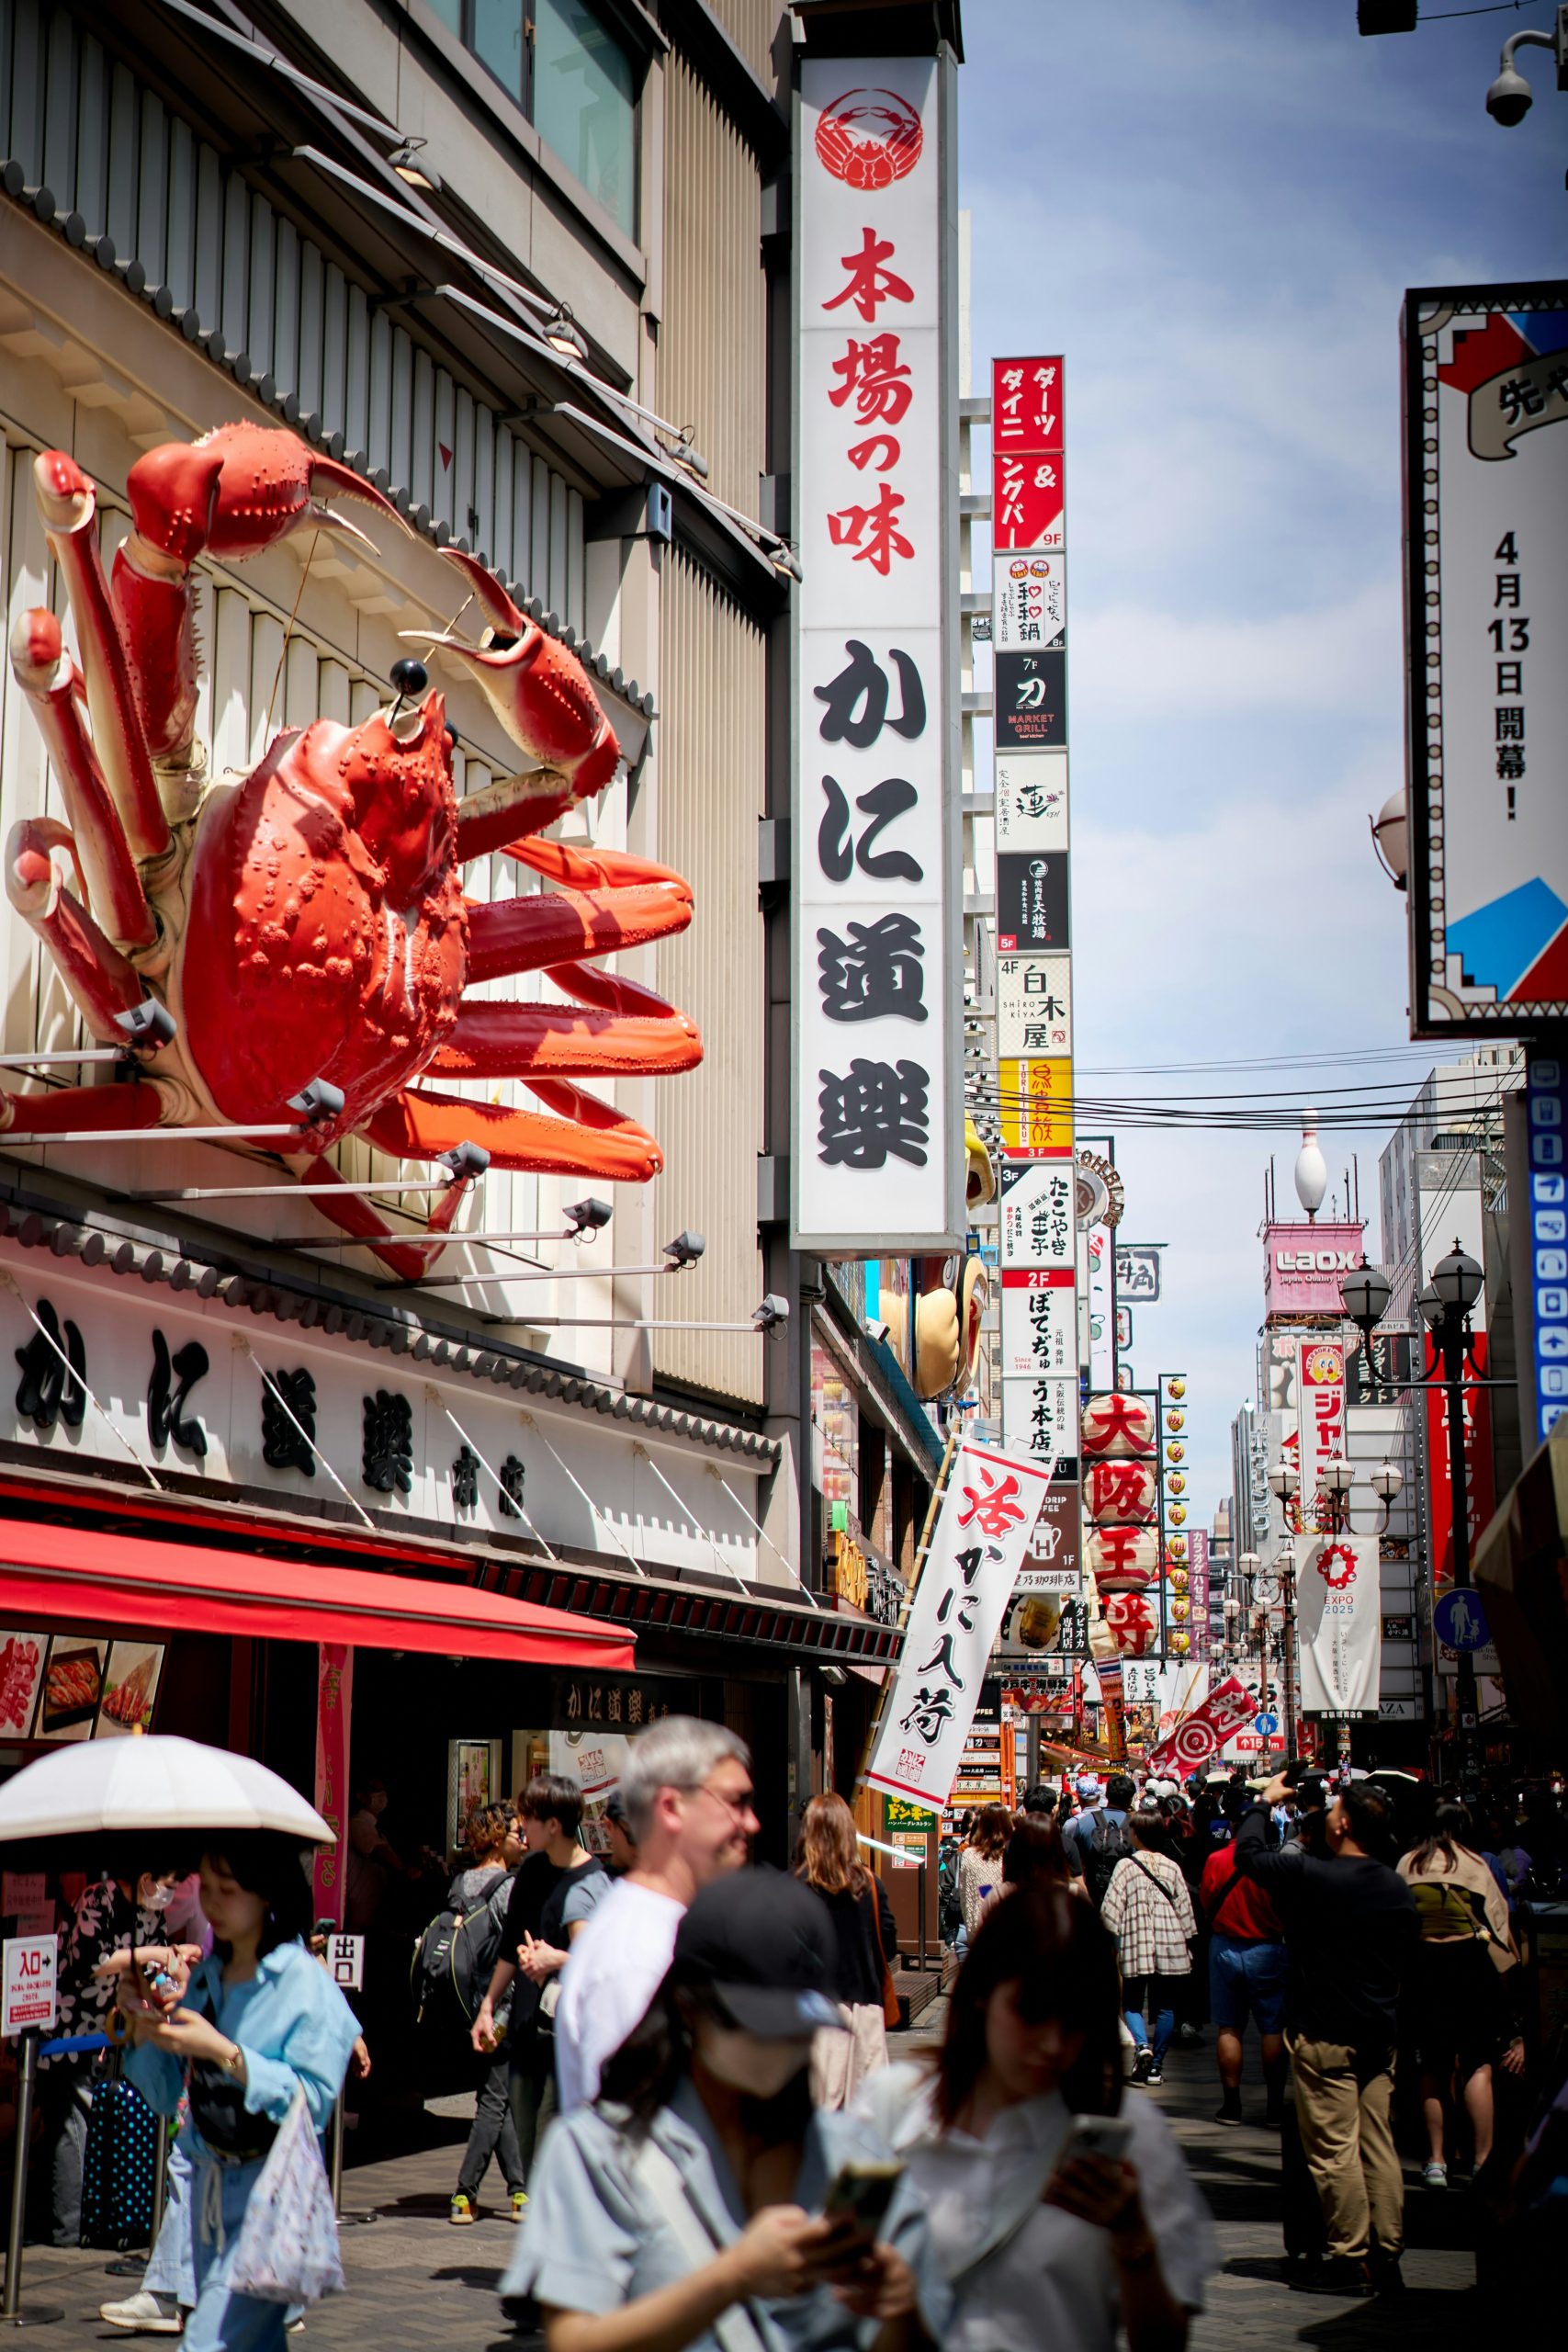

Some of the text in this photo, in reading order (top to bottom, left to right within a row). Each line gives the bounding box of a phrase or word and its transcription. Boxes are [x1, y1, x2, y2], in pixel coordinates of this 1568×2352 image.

[822, 228, 915, 576] 本場の味
[1033, 368, 1055, 488] ダーツ &
[1001, 369, 1024, 548] ダイニングバー
[1043, 534, 1062, 546] 9F
[1053, 639, 1064, 647] 8F
[1023, 658, 1038, 671] 7F
[1017, 677, 1046, 707] 刀
[1008, 714, 1055, 724] MARKET
[1015, 724, 1048, 733] GRILL
[1000, 938, 1013, 948] 5F
[1001, 961, 1019, 974] 4F
[1022, 965, 1066, 1047] 白木屋
[1003, 1170, 1018, 1182] 3F
[1050, 1177, 1069, 1256] たこやき
[1028, 1272, 1050, 1286] 2F
[1029, 1290, 1054, 1451] ぼてぢゅう本店
[1035, 1539, 1049, 1556] H
[1063, 1555, 1075, 1565] 1F
[1324, 1595, 1354, 1604] EXPO
[1325, 1605, 1354, 1614] 2025
[19, 1951, 41, 1978] 入口
[334, 1937, 355, 1983] 出口
